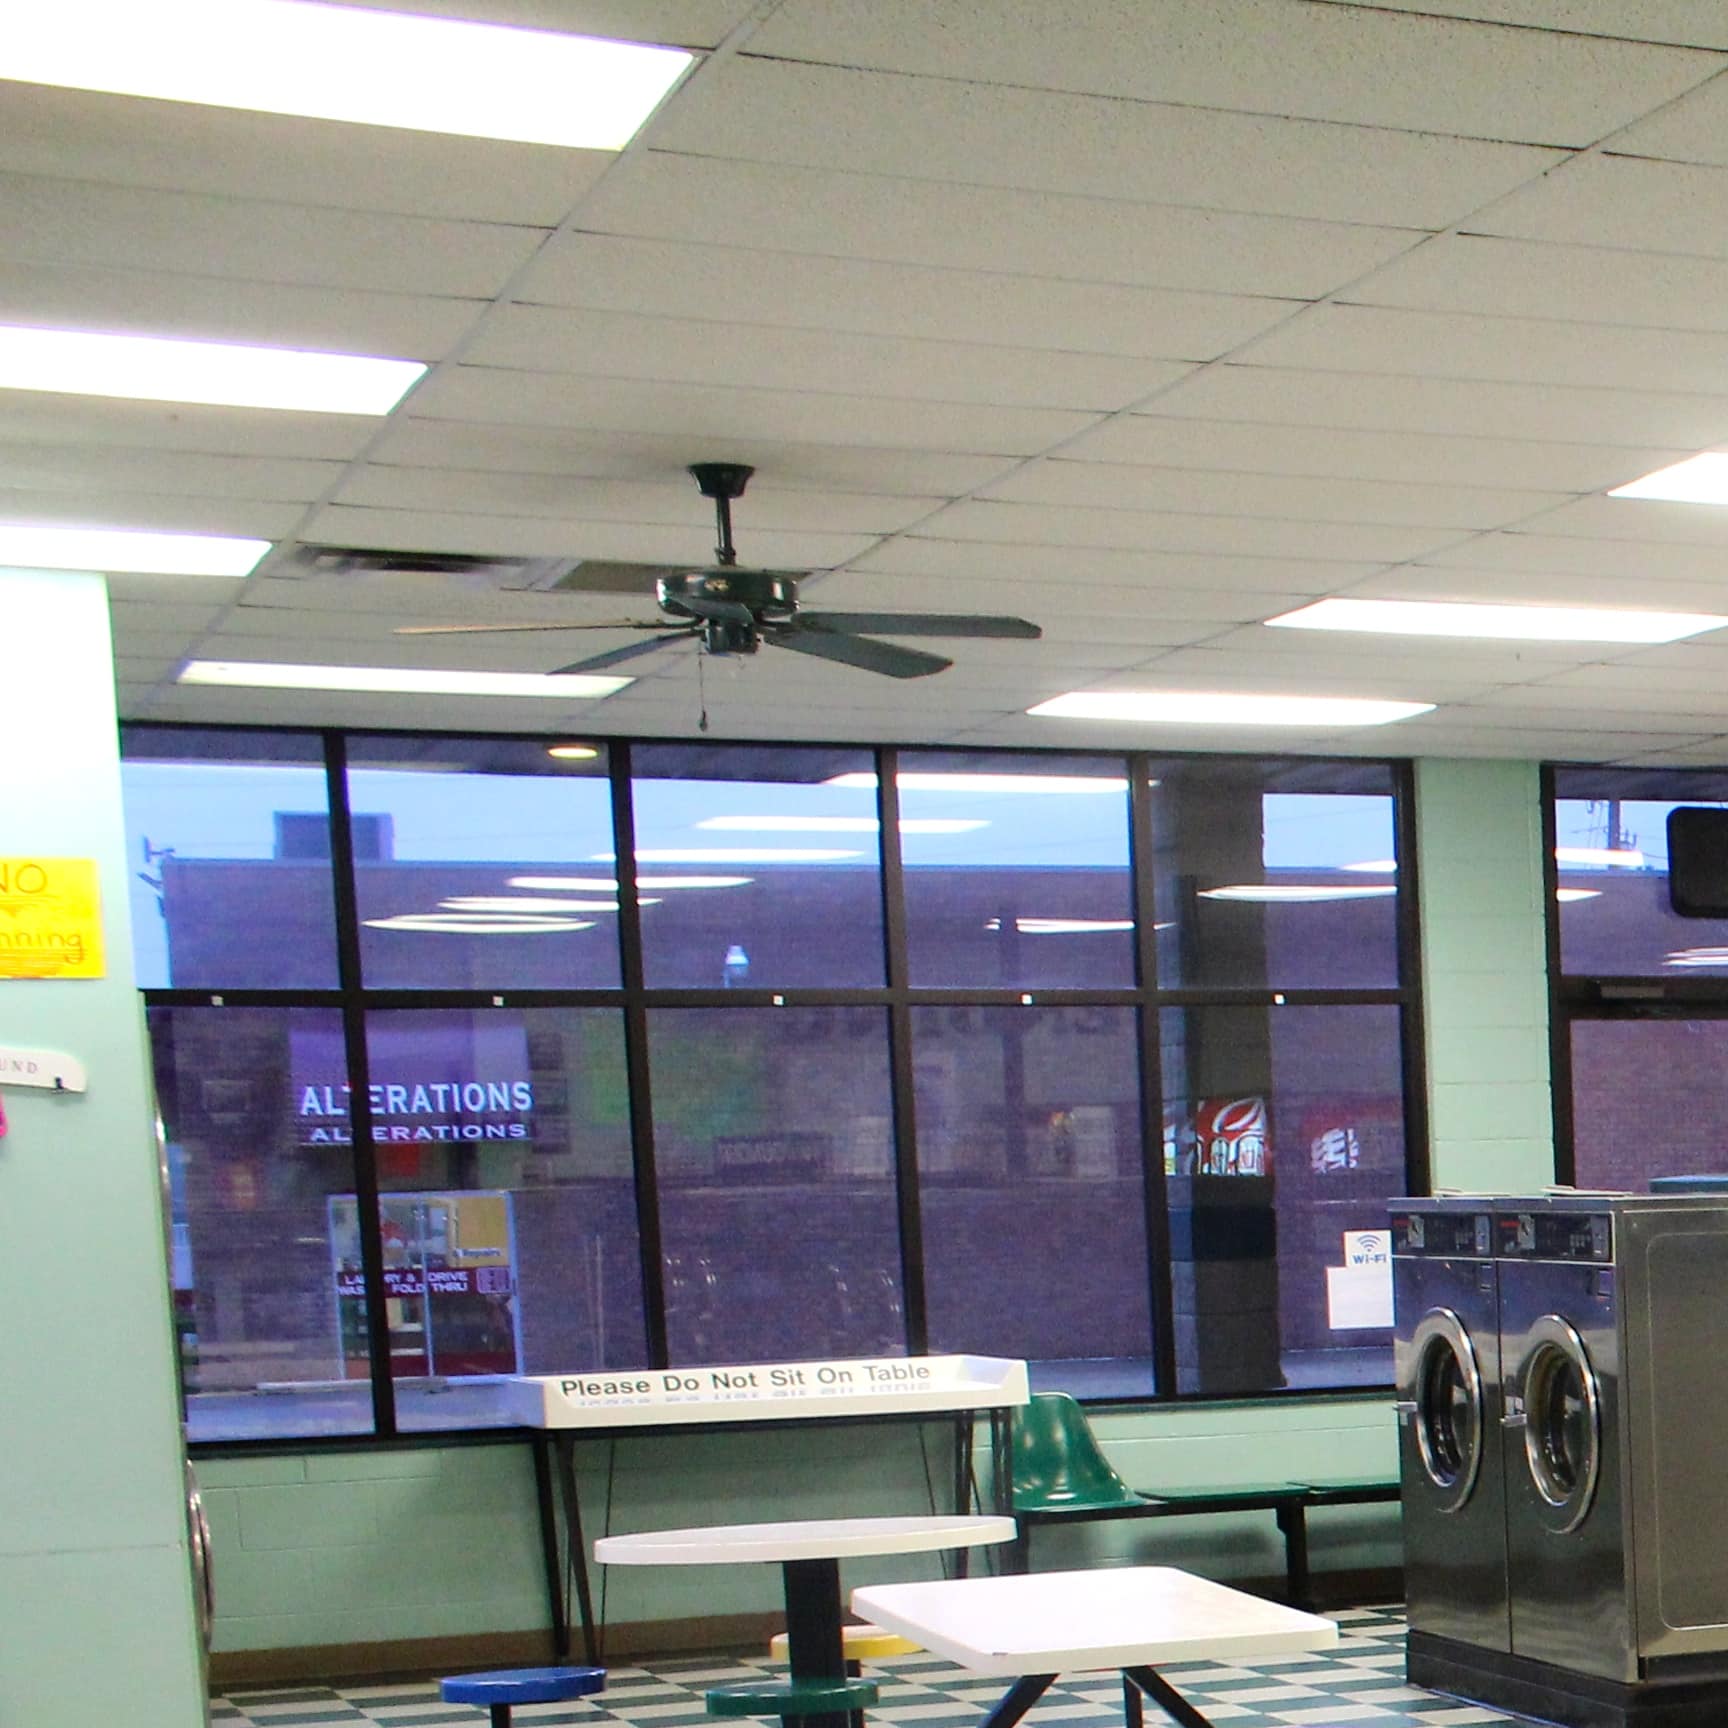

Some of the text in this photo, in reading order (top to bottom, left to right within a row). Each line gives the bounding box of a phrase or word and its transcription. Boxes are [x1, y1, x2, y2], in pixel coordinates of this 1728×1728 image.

[300, 1081, 533, 1116] ALERATIONS
[310, 1123, 526, 1142] ALERATIONS
[560, 1363, 930, 1397] Please Do Not Sit On Table
